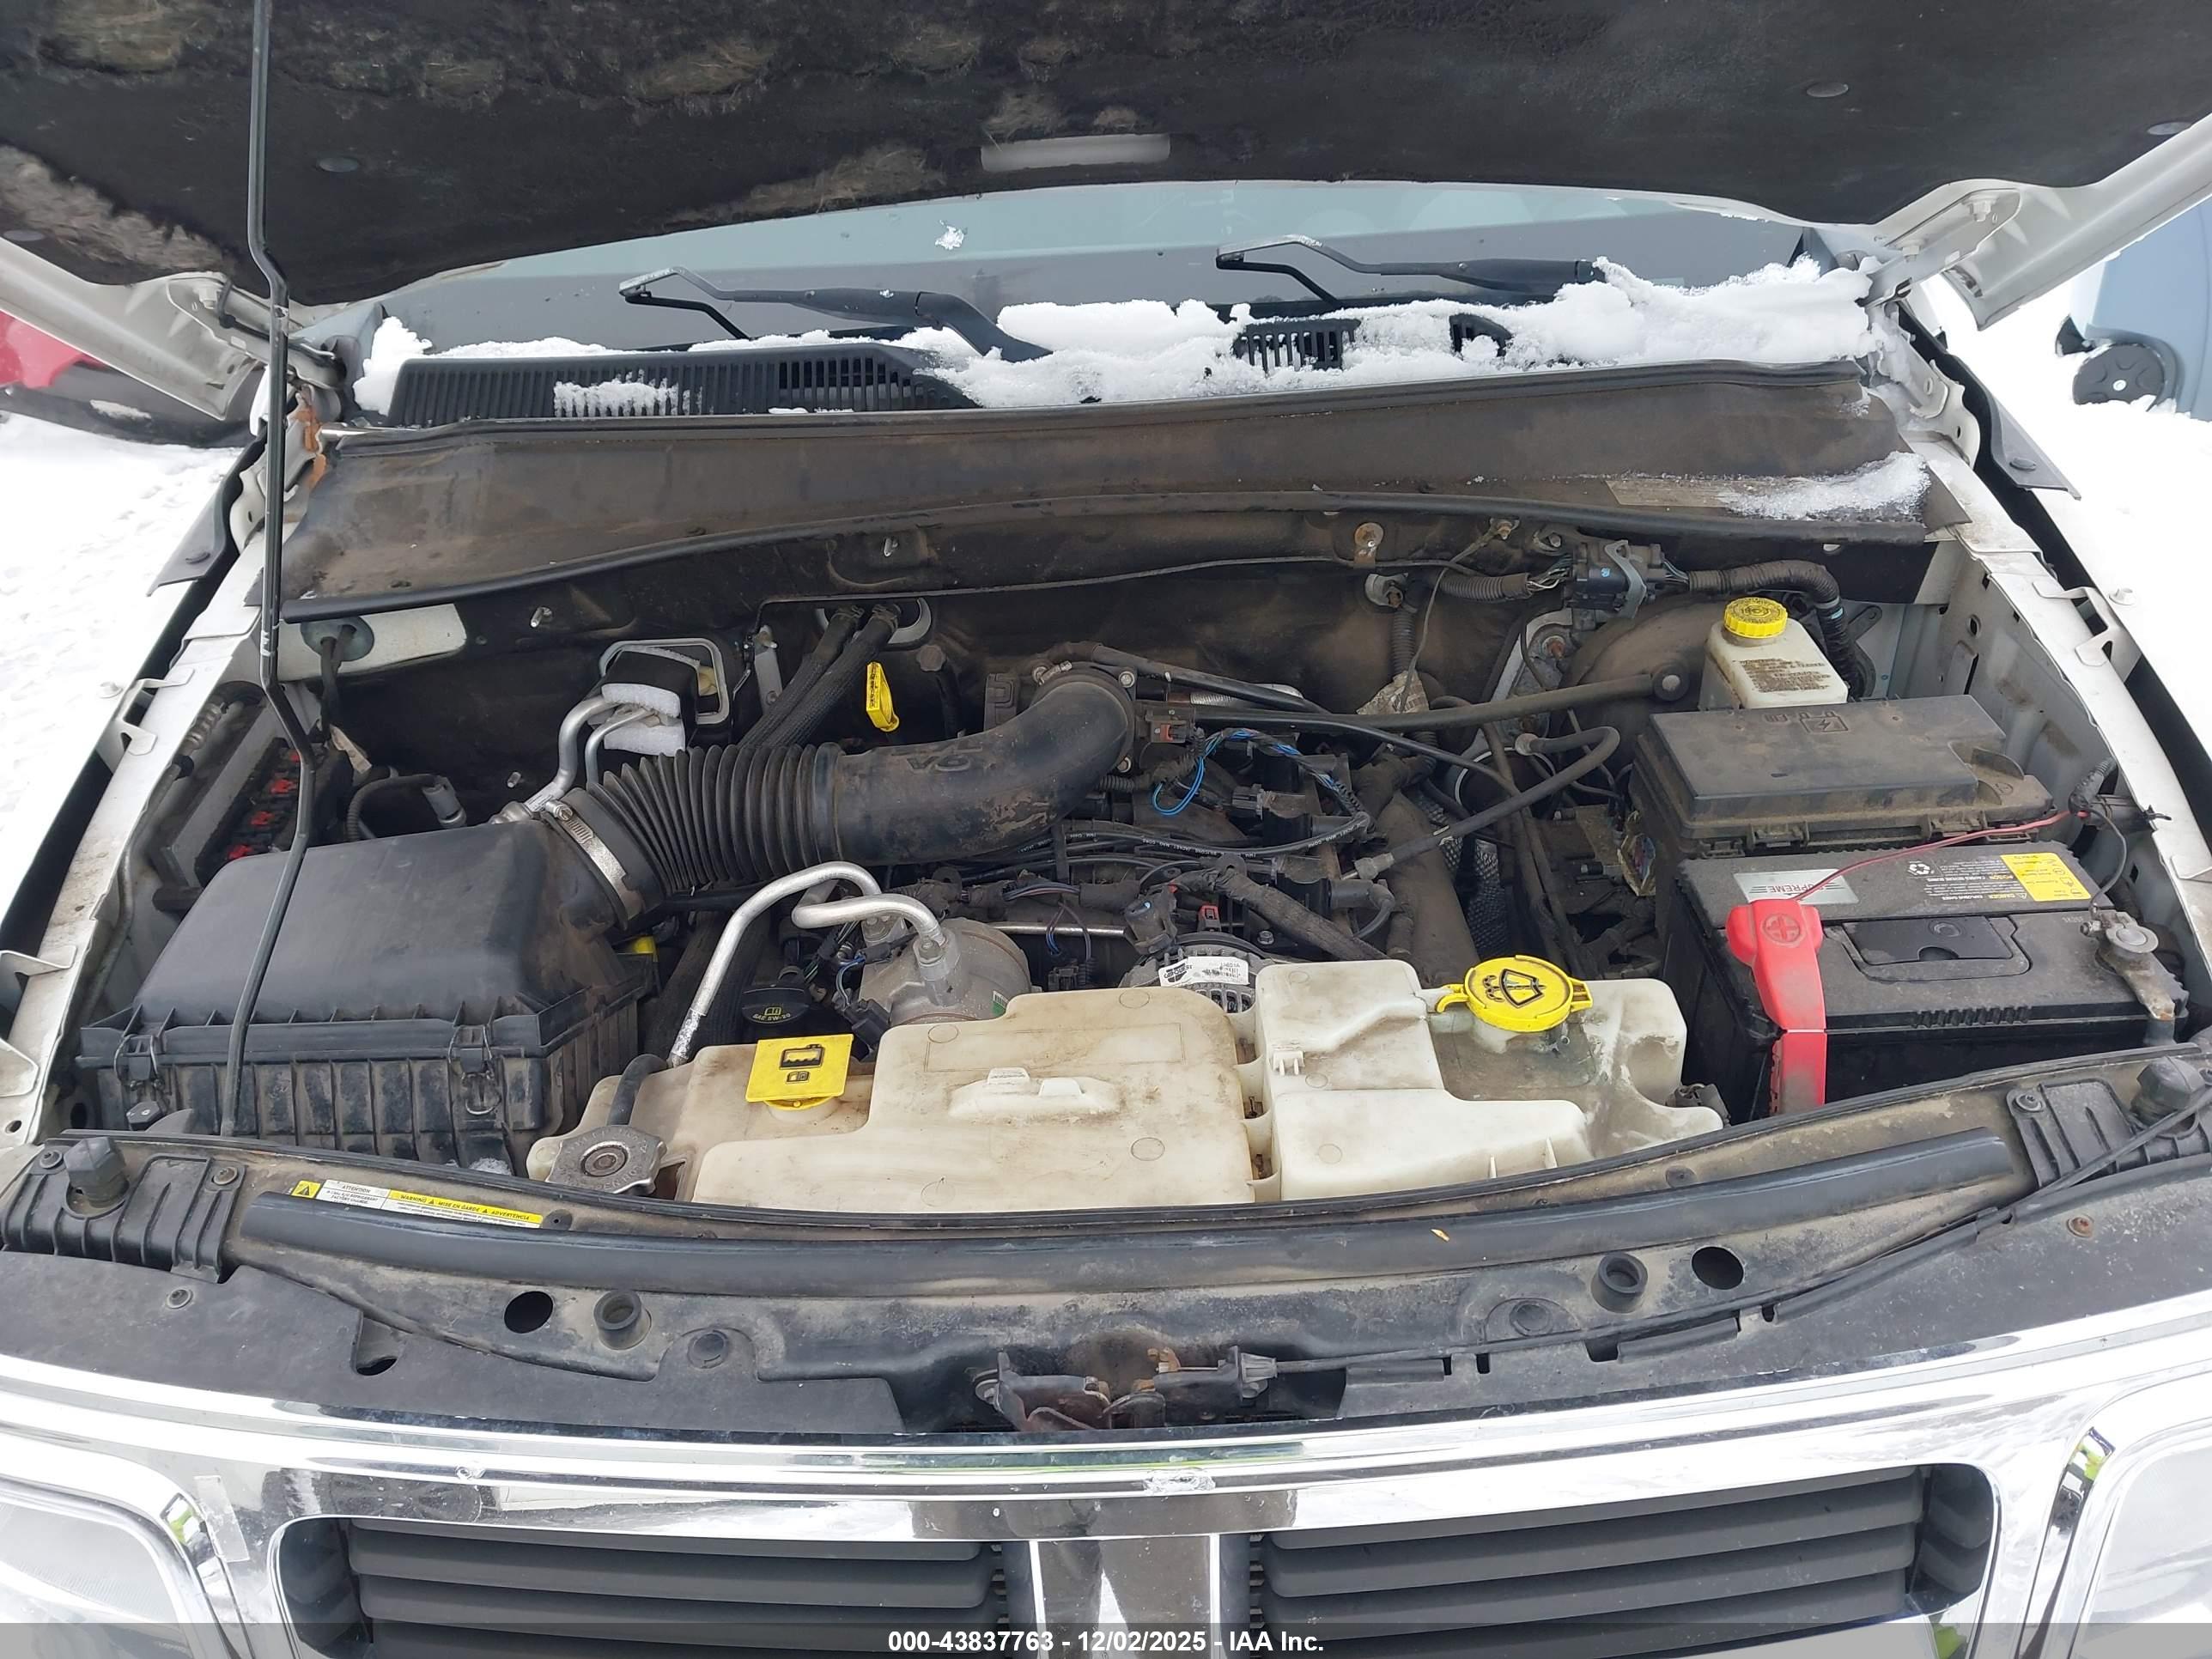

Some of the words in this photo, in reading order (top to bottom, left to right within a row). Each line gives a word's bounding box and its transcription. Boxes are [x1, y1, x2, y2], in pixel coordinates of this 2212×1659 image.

[341, 1184, 372, 1194] ATTENTION
[400, 1194, 427, 1204] WARNING
[461, 1204, 480, 1212] GARDE
[491, 1210, 530, 1221] ADVERTENCIA
